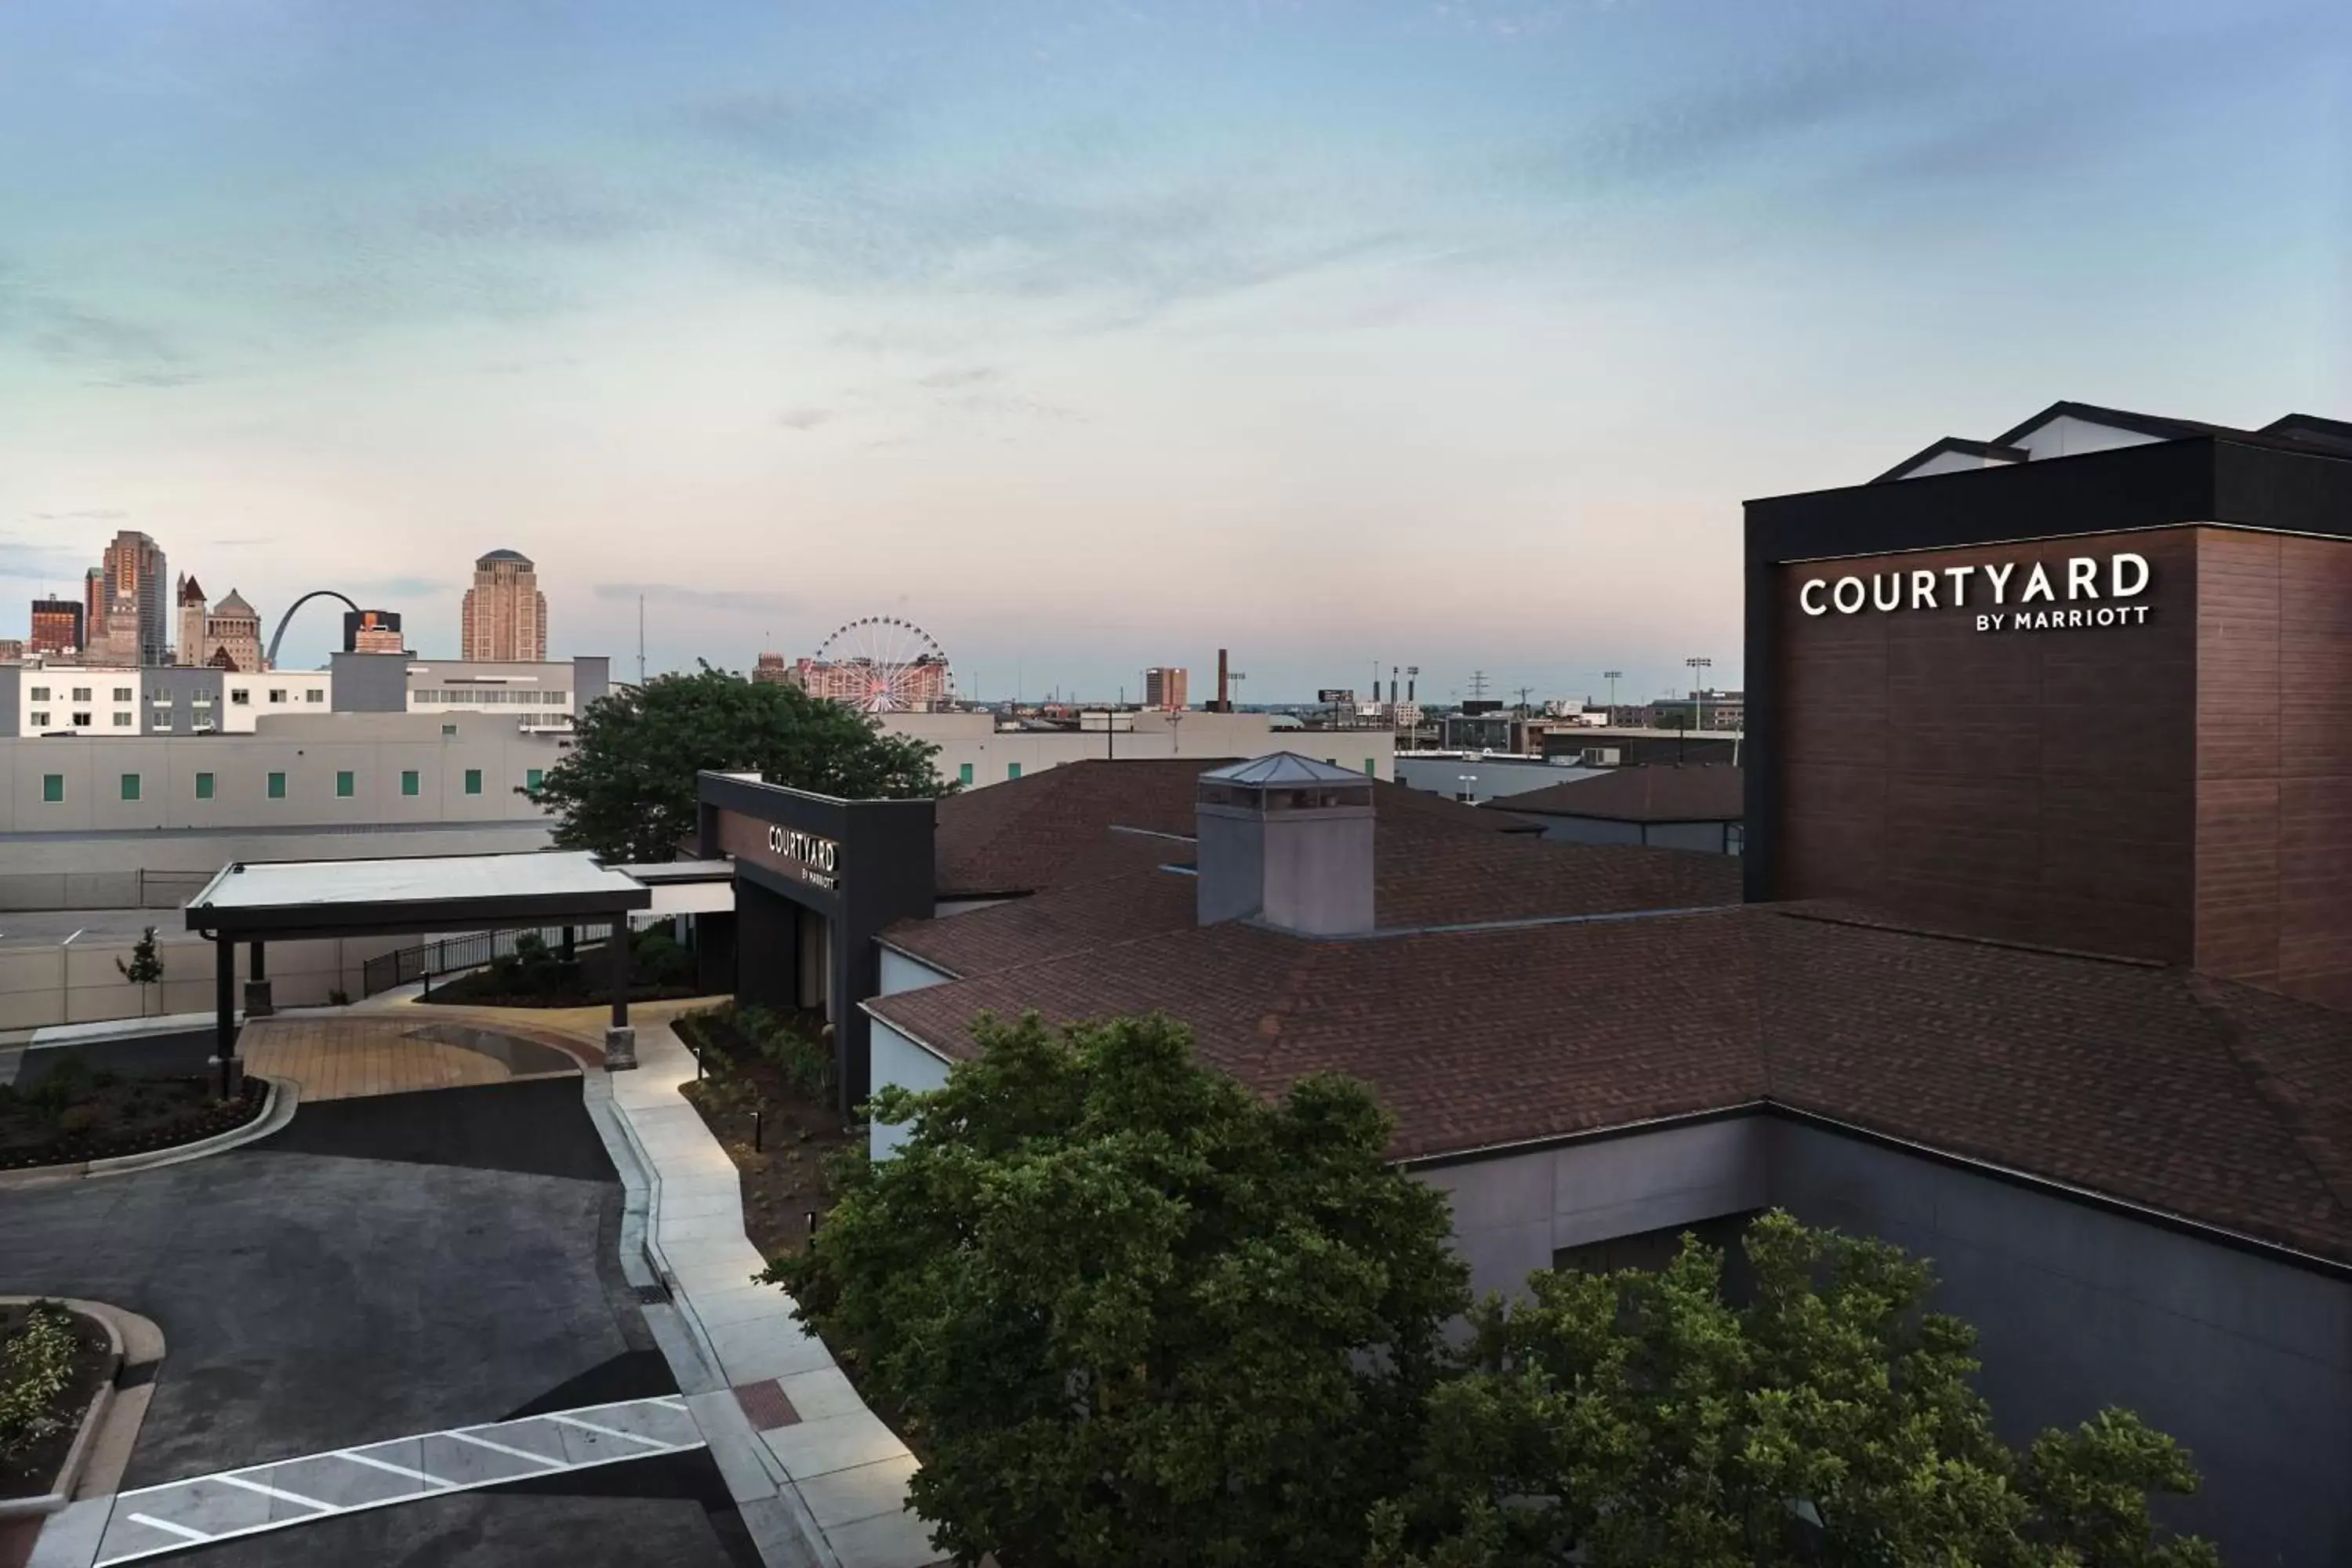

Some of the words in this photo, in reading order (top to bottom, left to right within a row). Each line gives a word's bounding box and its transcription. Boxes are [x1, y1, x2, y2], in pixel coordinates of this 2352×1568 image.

[1800, 553, 2149, 615] COURTYARD
[1976, 614, 2005, 631] BY
[2015, 606, 2149, 630] MARRIOTT
[769, 826, 833, 871] COURTYARD
